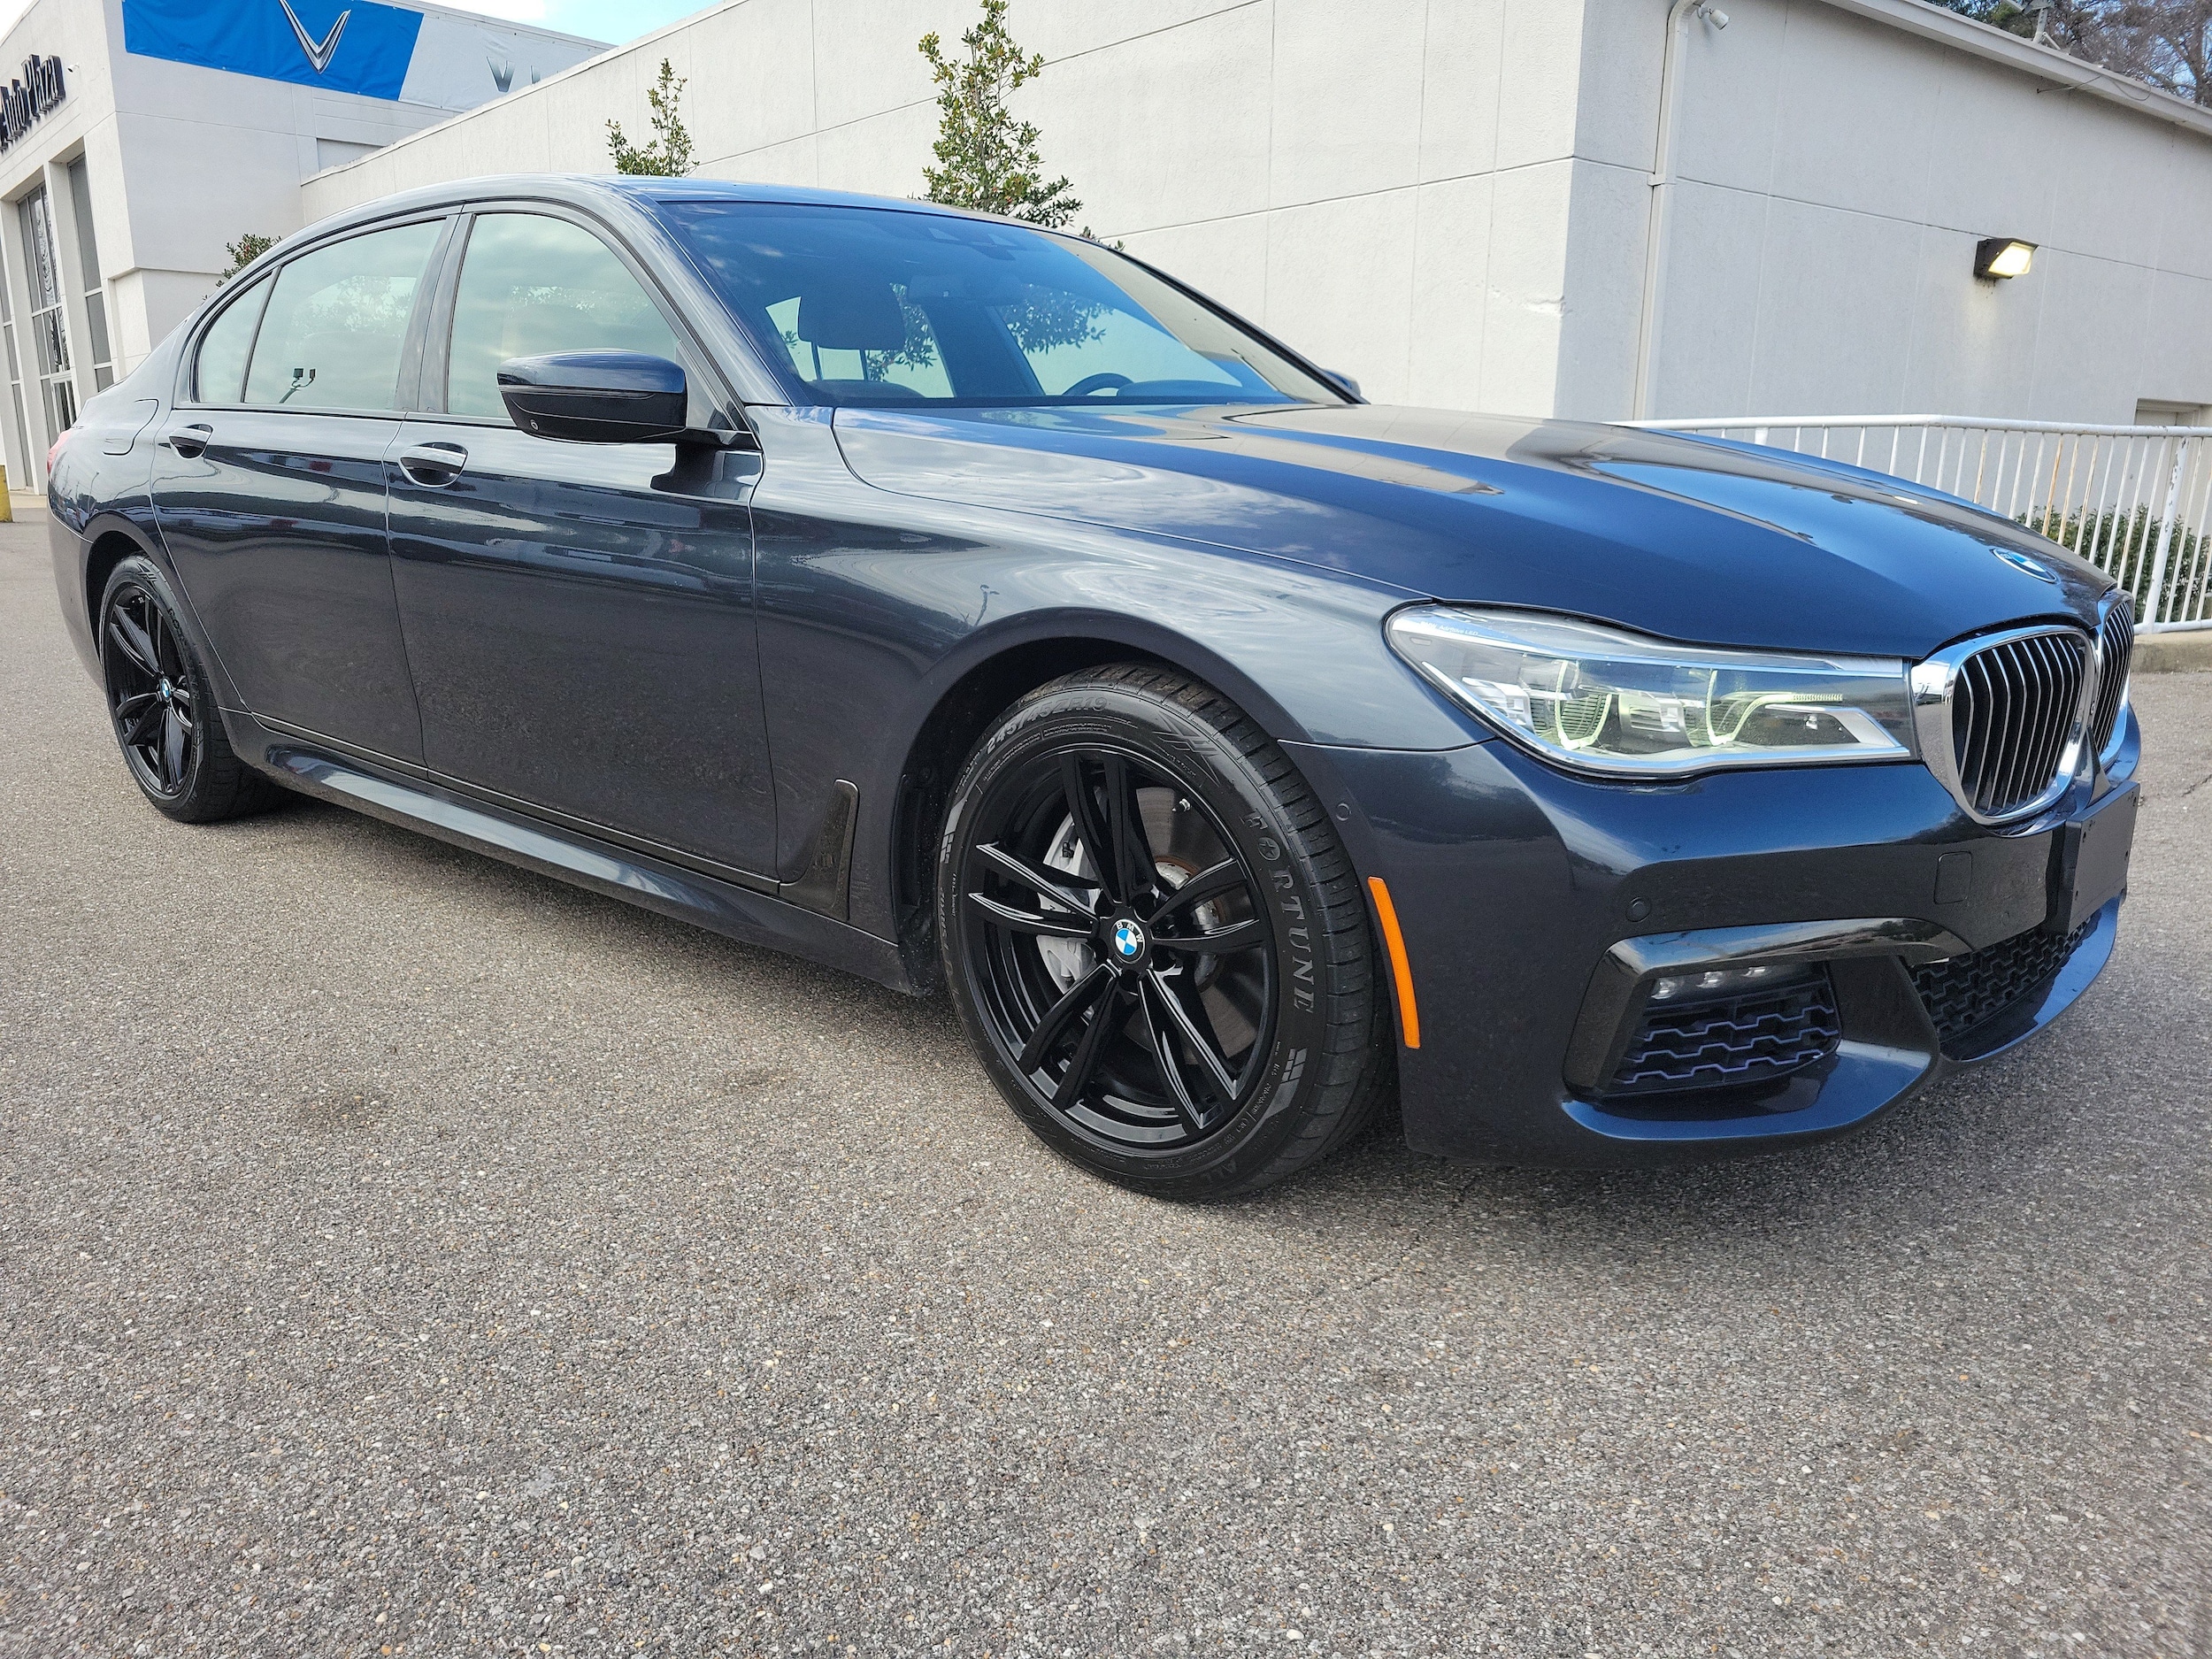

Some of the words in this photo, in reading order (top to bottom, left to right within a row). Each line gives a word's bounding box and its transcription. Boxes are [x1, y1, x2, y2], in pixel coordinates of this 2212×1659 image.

[21, 54, 64, 120] Plaza
[486, 57, 558, 93] VI
[1116, 922, 1143, 943] BMW
[1240, 809, 1315, 1013] FORTUNE
